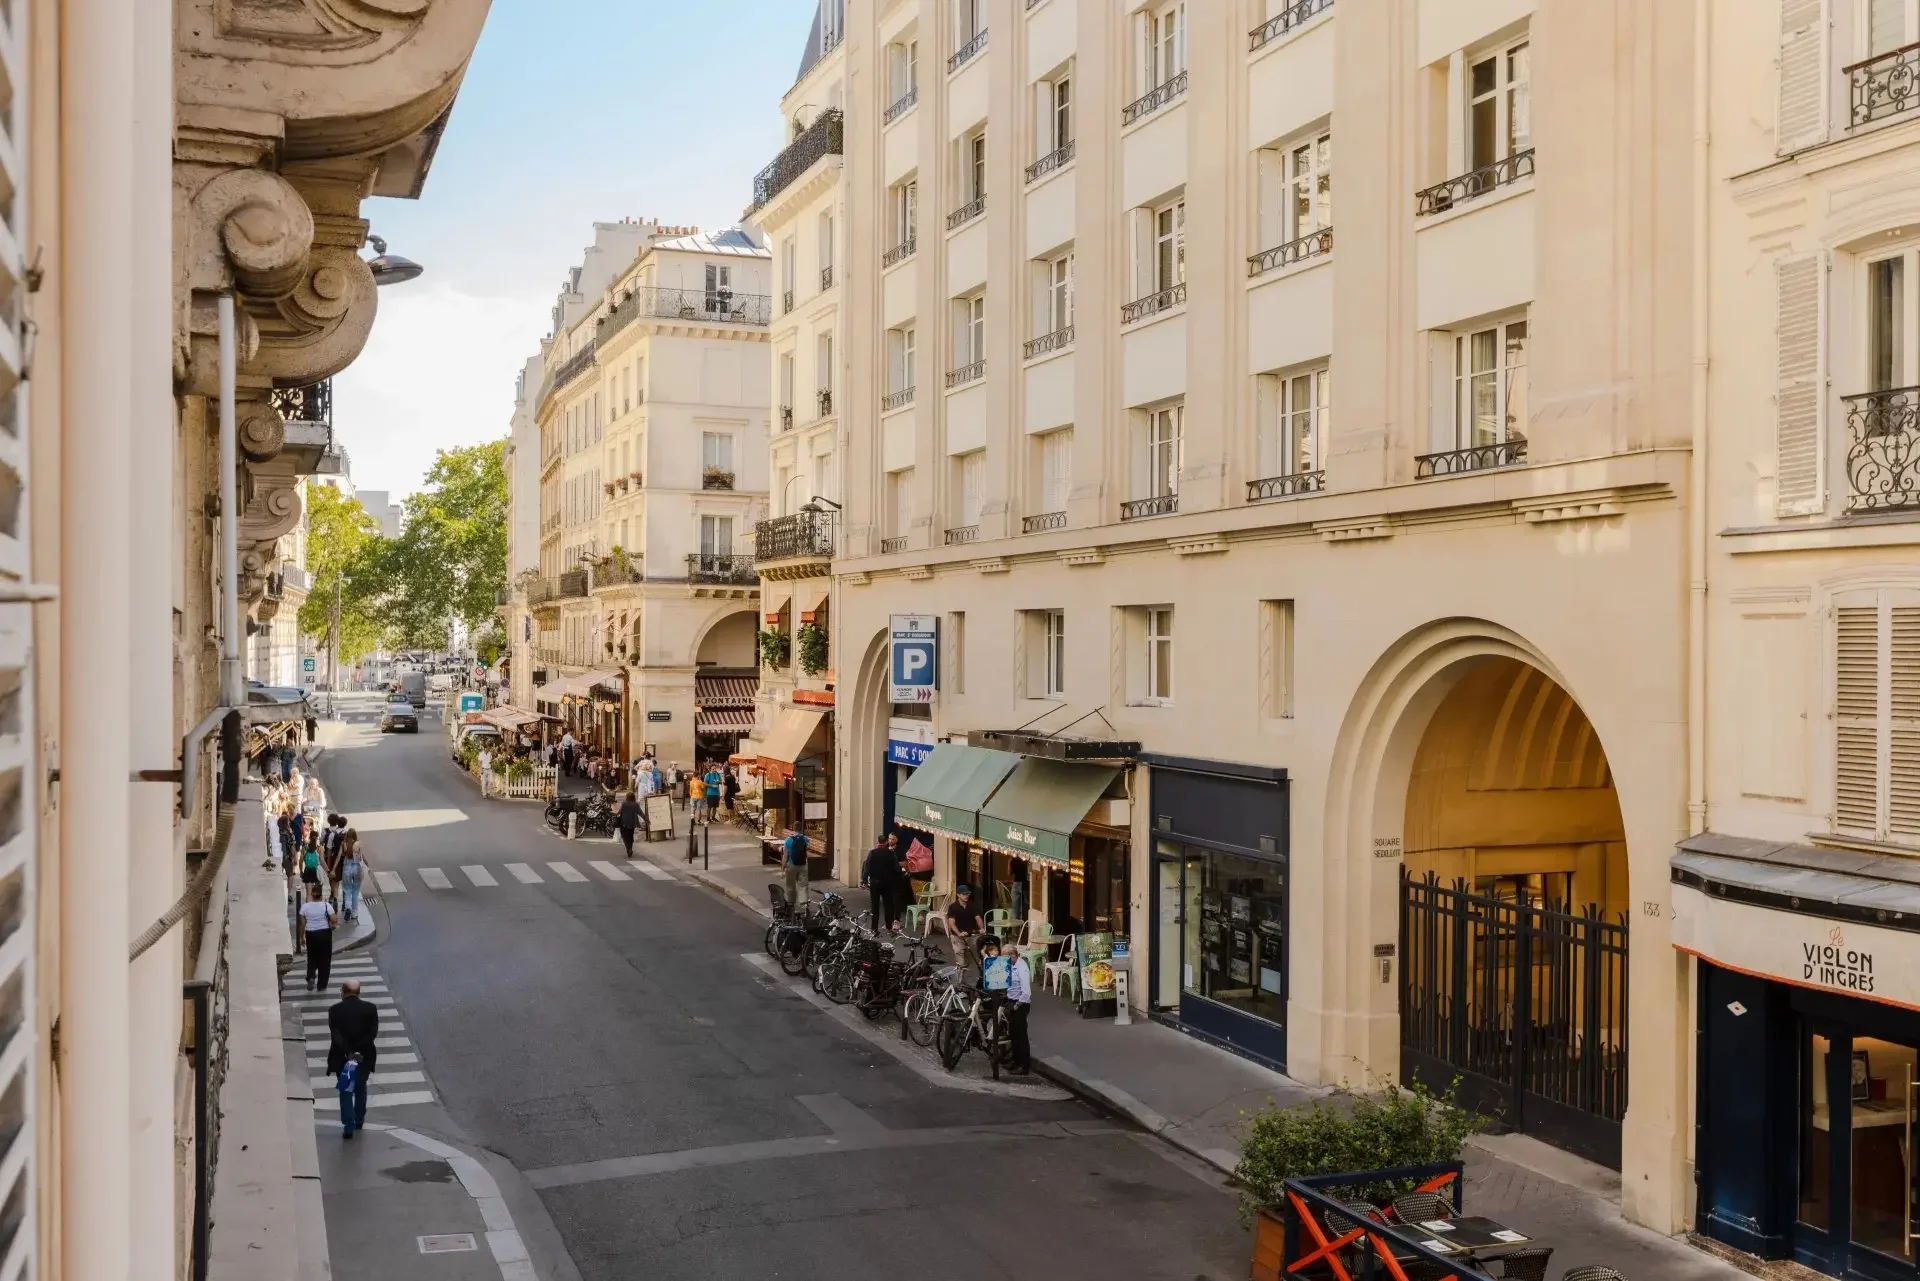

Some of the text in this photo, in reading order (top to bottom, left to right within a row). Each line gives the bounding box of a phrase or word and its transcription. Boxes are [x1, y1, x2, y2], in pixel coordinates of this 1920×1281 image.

[904, 648, 927, 680] P
[705, 697, 754, 705] FONTAINE
[895, 745, 909, 760] PARC
[1006, 826, 1037, 845] Juice Bar
[1643, 901, 1660, 917] 133
[1829, 926, 1844, 946] Le
[1803, 942, 1873, 974] VIOLON
[1804, 961, 1874, 992] D'INGRES
